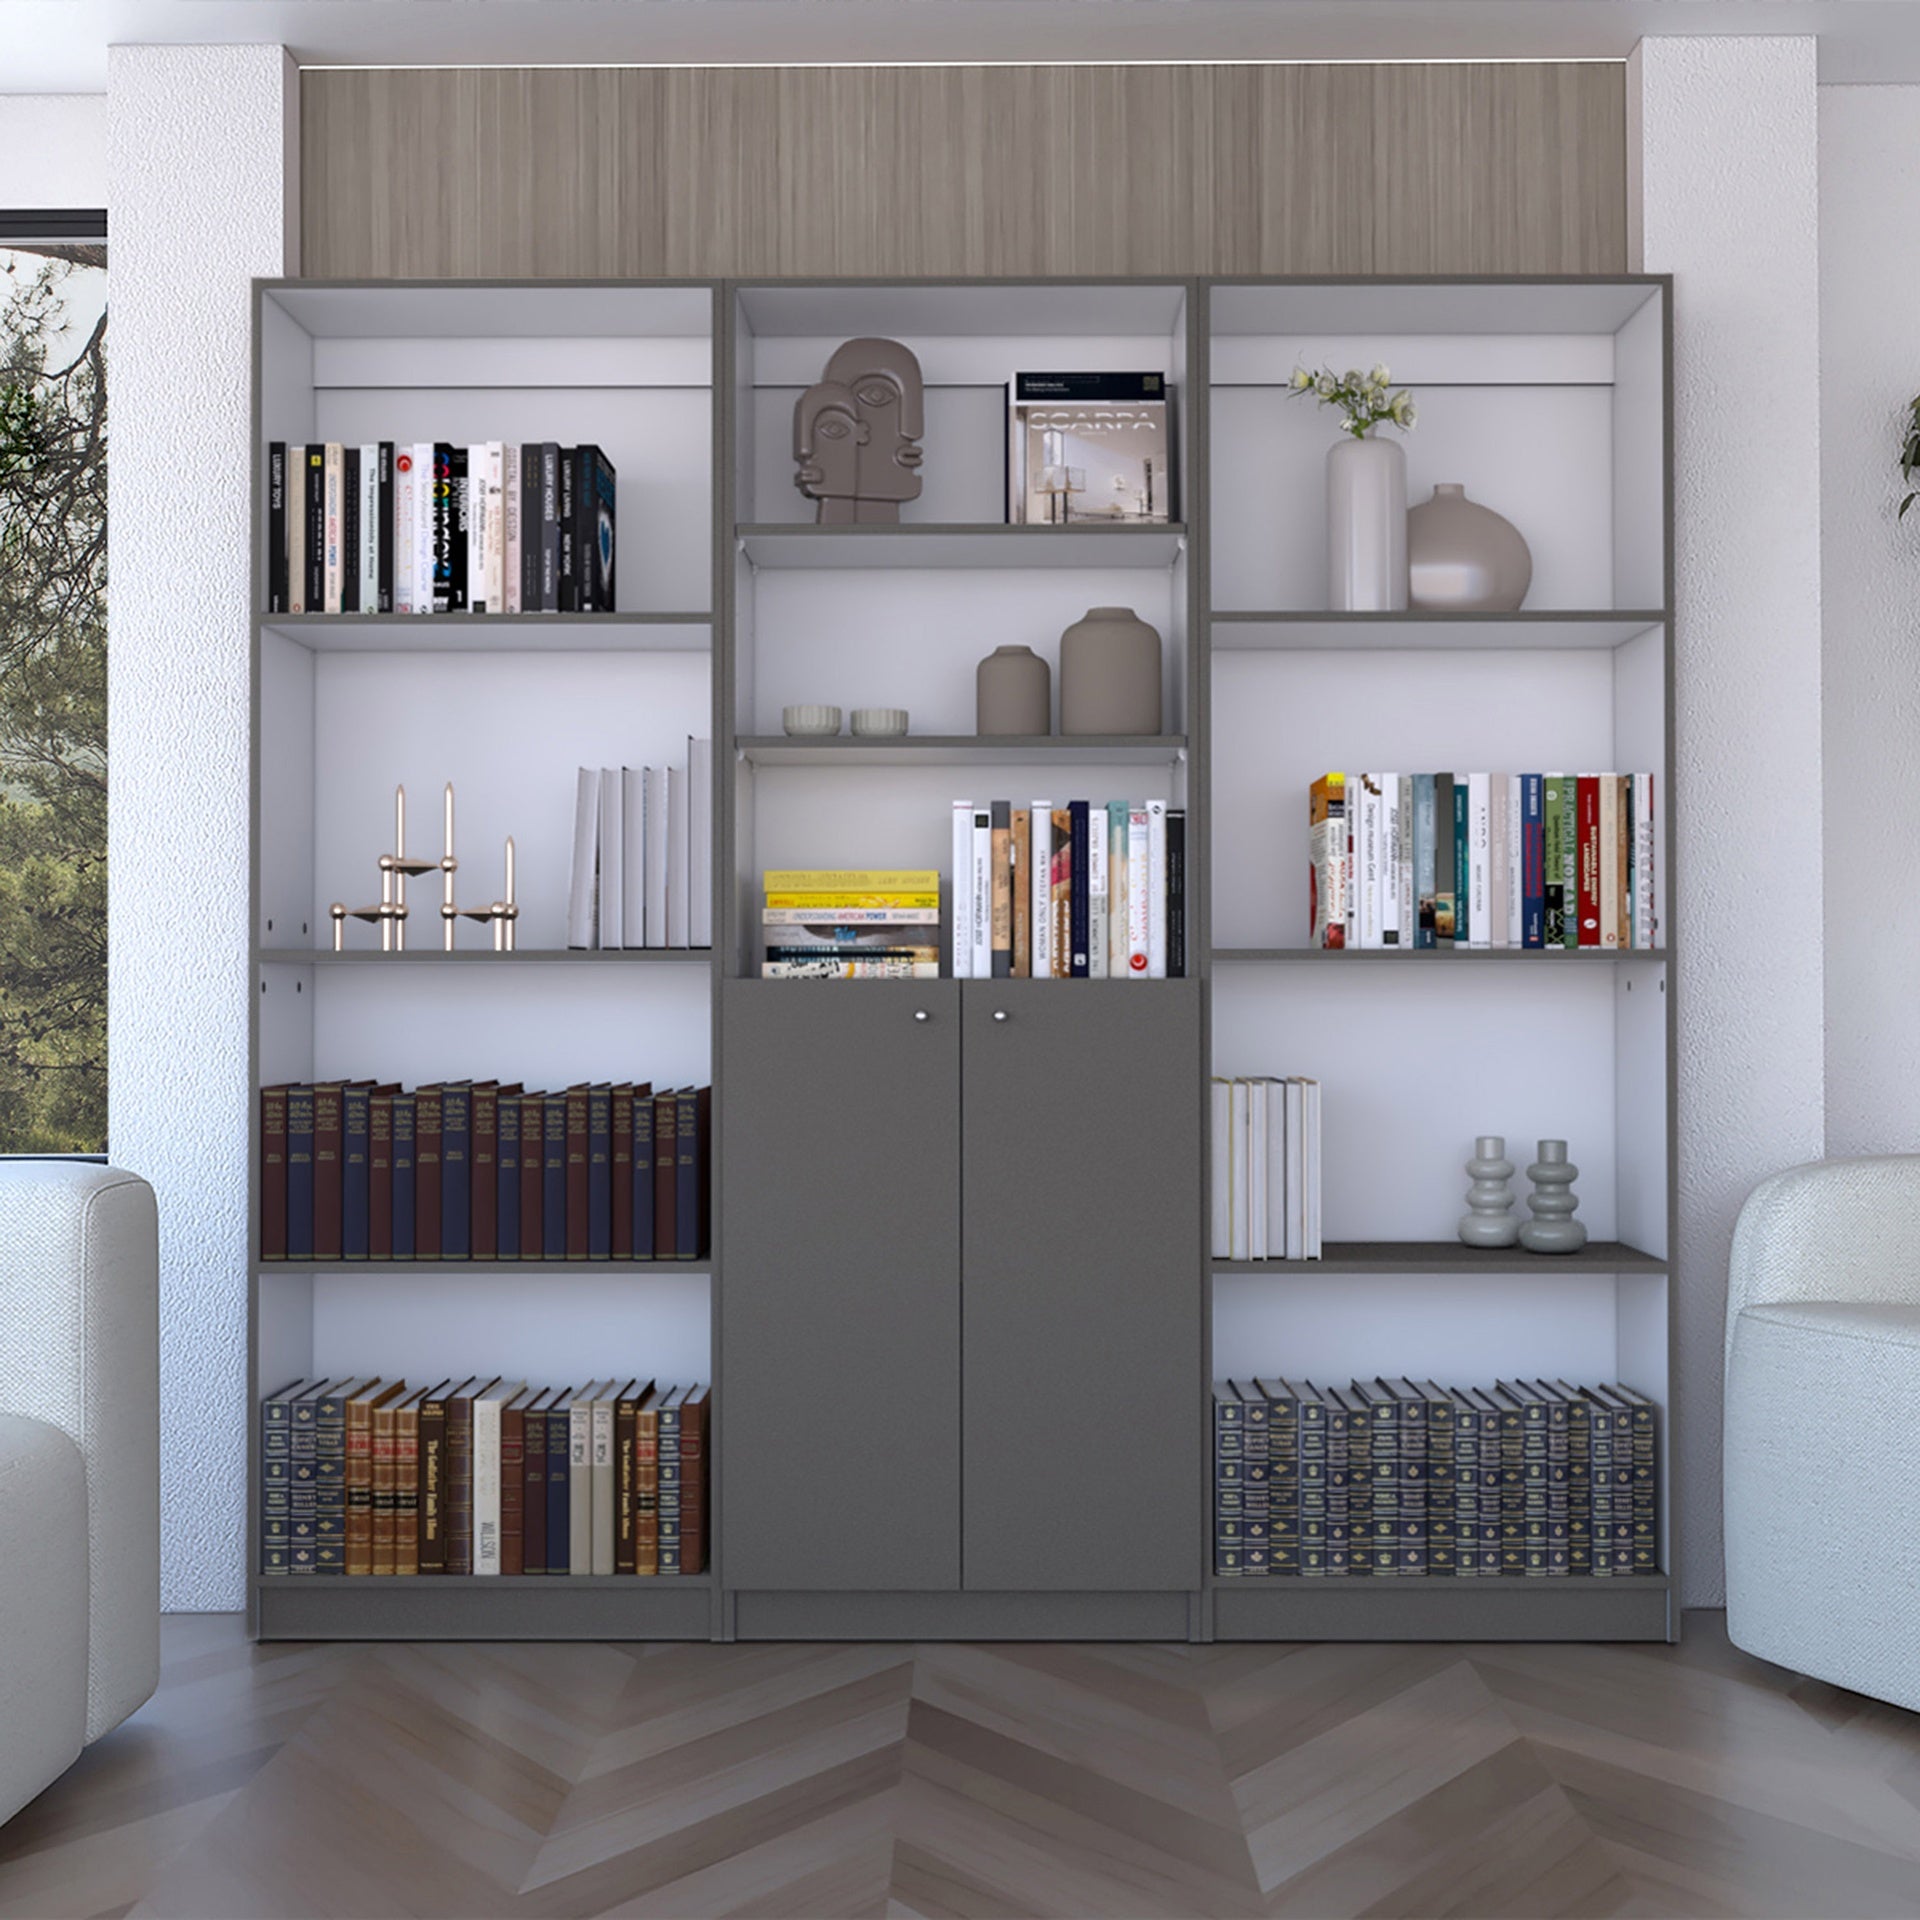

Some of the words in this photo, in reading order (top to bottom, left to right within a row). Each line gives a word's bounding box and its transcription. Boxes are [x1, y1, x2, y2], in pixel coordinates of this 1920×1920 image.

[1030, 412, 1156, 430] SCARPA
[272, 453, 281, 486] LUXURY
[544, 453, 554, 486] LUXURY
[563, 459, 572, 491] LUXURY
[563, 533, 572, 552] NEW
[328, 545, 336, 566] POWER
[563, 552, 572, 577] YORK
[1563, 853, 1577, 915] NOMAD
[1038, 900, 1047, 924] ONLY
